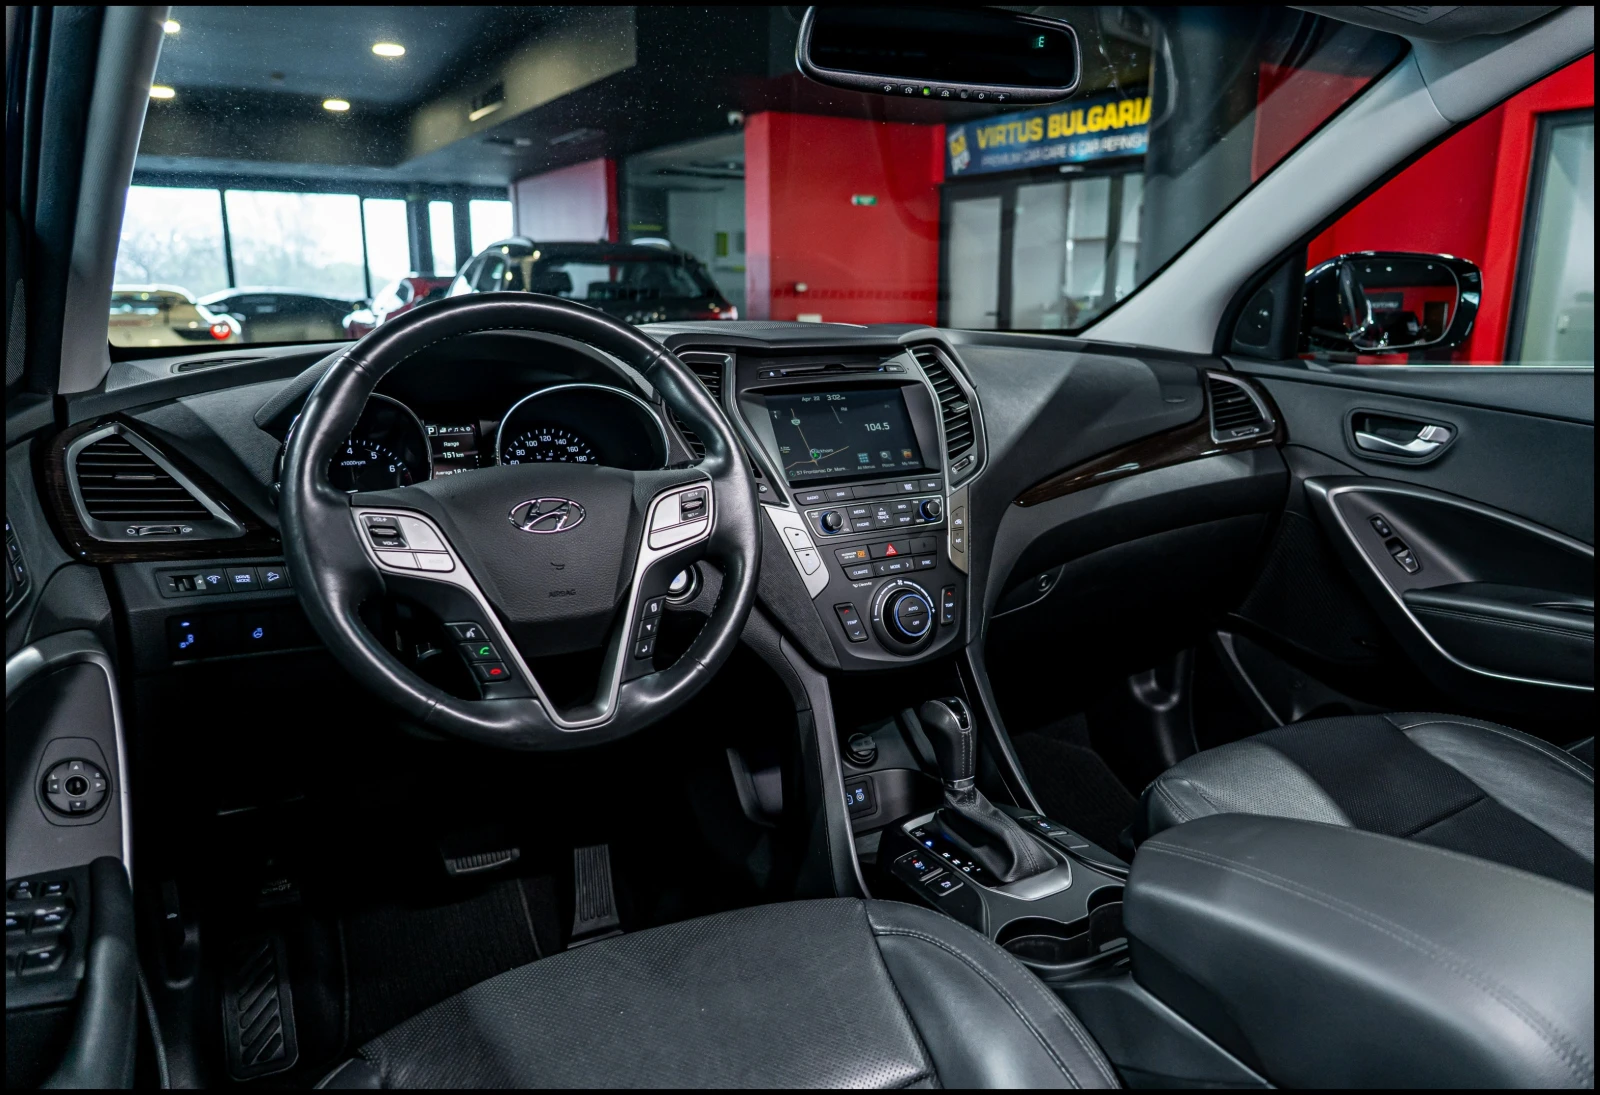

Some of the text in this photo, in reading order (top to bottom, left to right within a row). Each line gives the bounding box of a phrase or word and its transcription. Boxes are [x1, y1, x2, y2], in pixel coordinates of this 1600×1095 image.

[1038, 36, 1045, 48] E
[976, 117, 1044, 149] VIRTUS
[864, 422, 890, 431] 104.5
[346, 447, 354, 455] 4
[370, 451, 378, 459] 5
[389, 464, 396, 472] 6
